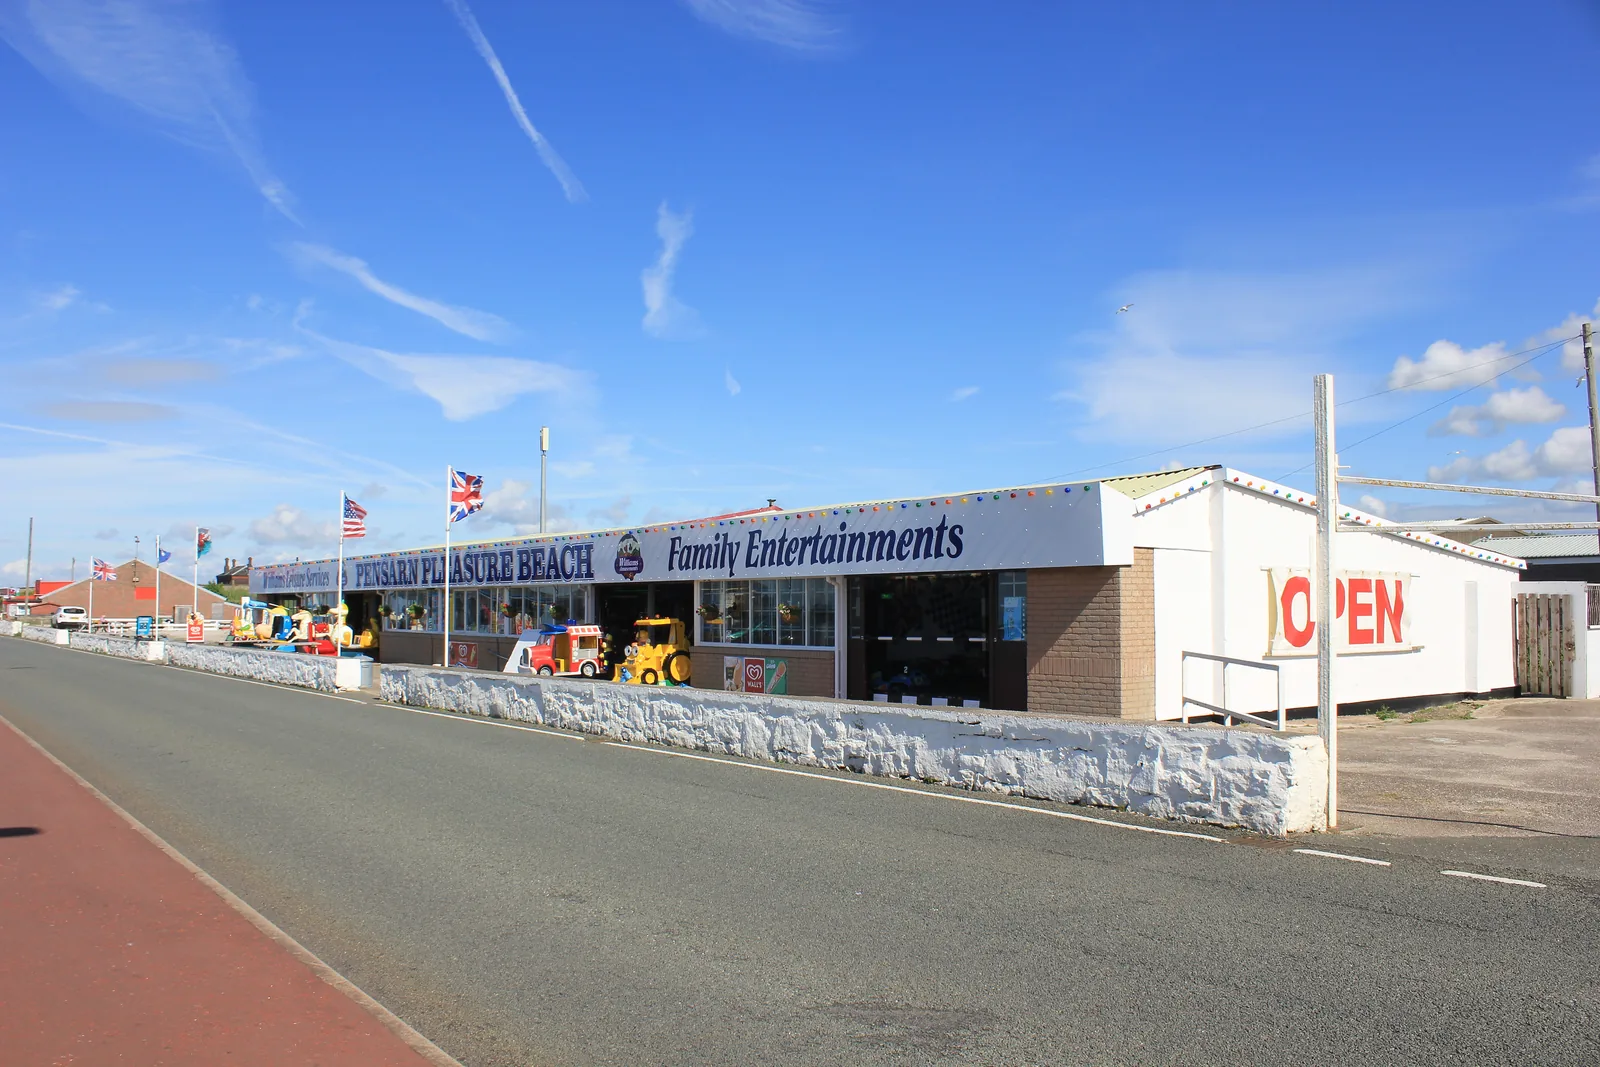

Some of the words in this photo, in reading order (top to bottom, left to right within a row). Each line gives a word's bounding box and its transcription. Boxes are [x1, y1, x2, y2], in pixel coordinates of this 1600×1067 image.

[355, 558, 419, 587] PENSARN
[421, 550, 514, 585] PLEASURE
[517, 542, 595, 582] BEACH
[668, 532, 740, 578] Family
[745, 514, 963, 568] Entertainments
[306, 567, 330, 587] Services
